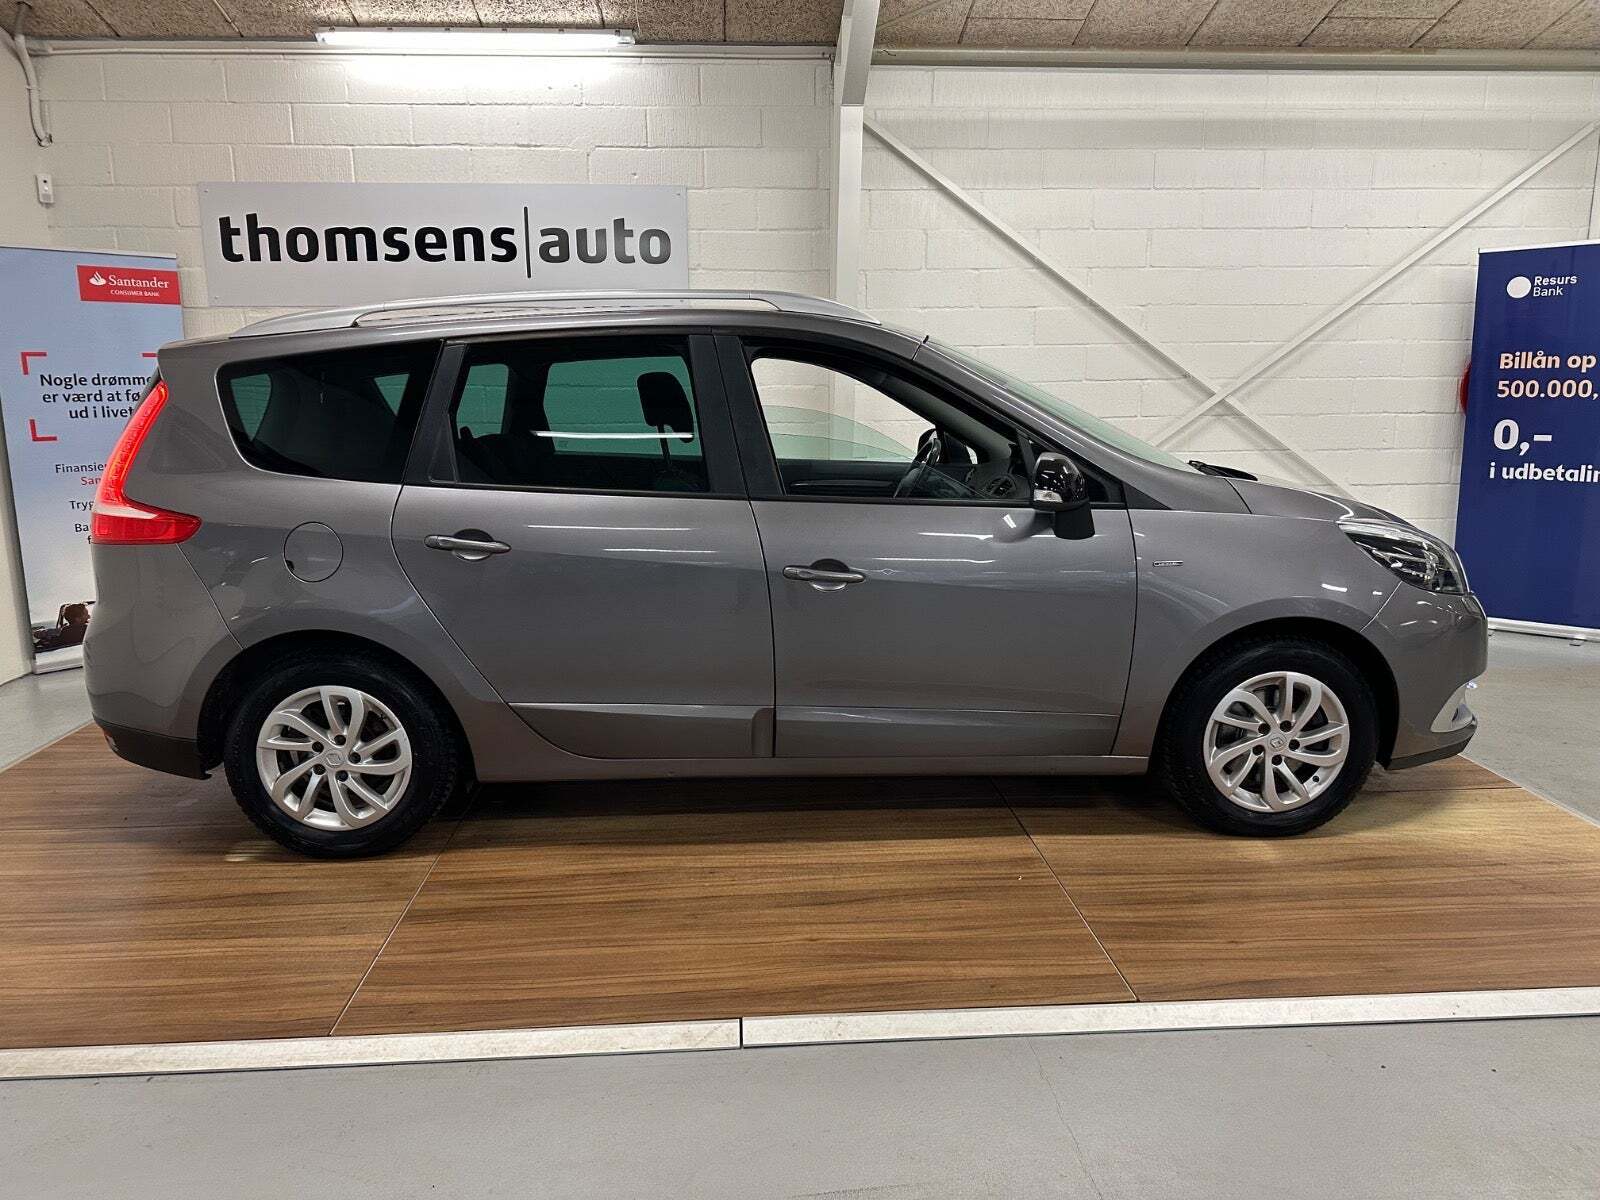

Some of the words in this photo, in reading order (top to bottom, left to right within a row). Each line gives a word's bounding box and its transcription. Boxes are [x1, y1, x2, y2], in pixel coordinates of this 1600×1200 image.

[218, 212, 518, 263] thomsens
[539, 217, 672, 265] auto
[108, 274, 170, 289] Santander
[1534, 275, 1578, 286] Resurs
[110, 289, 143, 297] CONSUMER
[1533, 286, 1563, 297] Bank
[1500, 350, 1560, 370] Billån
[1567, 355, 1597, 373] op
[40, 374, 88, 390] Nogle
[1496, 379, 1599, 400] 500.000,
[42, 392, 60, 403] er
[62, 389, 103, 403] værd
[104, 390, 122, 402] at
[69, 407, 89, 419] ud
[93, 406, 98, 419] i
[102, 405, 134, 418] livet
[1489, 462, 1496, 479] i
